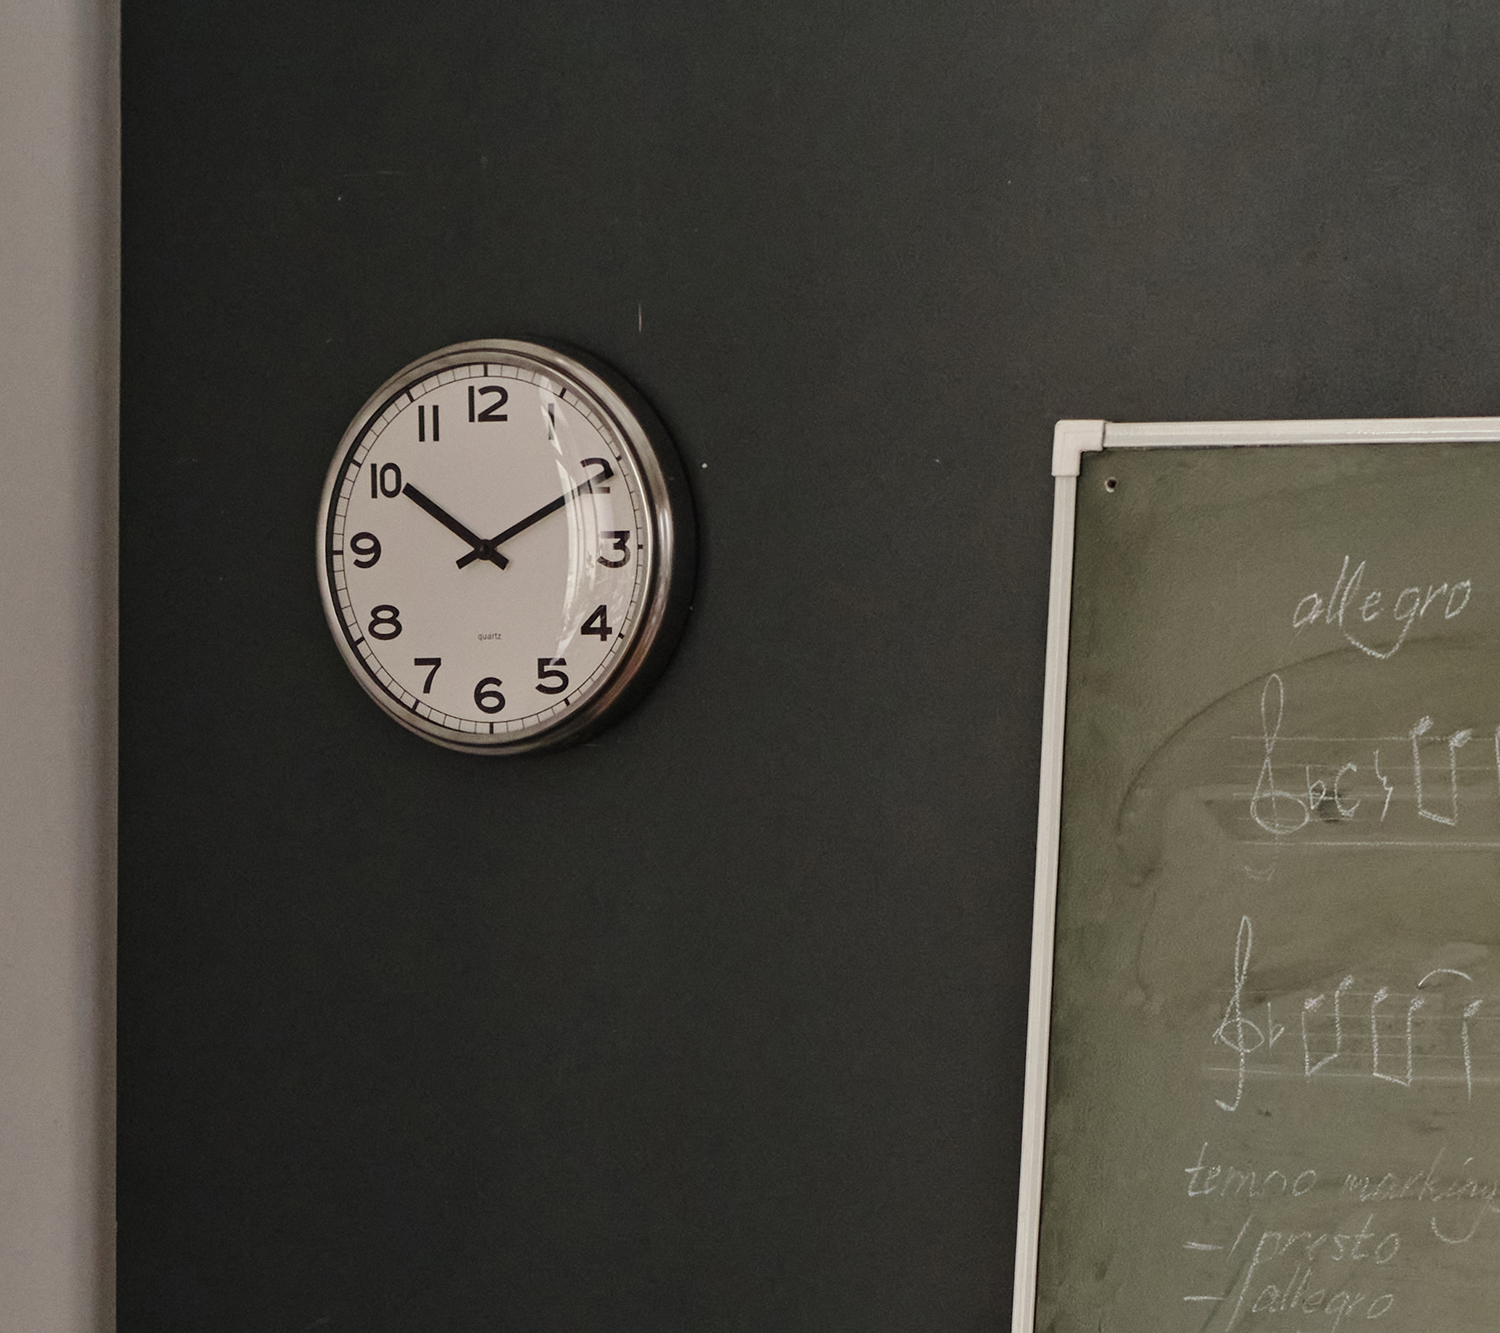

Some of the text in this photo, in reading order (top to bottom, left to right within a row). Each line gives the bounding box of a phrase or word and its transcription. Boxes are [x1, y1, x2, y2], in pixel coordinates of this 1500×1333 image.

[468, 385, 509, 422] 12
[547, 403, 556, 440] 1
[418, 405, 440, 442] 11
[370, 462, 402, 499] 10
[579, 457, 614, 494] 2
[350, 532, 382, 569] 9
[596, 530, 631, 568] 3
[368, 604, 403, 641] 8
[580, 604, 613, 641] 4
[1293, 555, 1472, 659] allegro
[477, 632, 502, 641] quartz
[414, 657, 442, 694] 7
[534, 657, 569, 695] 5
[473, 677, 506, 714] 6
